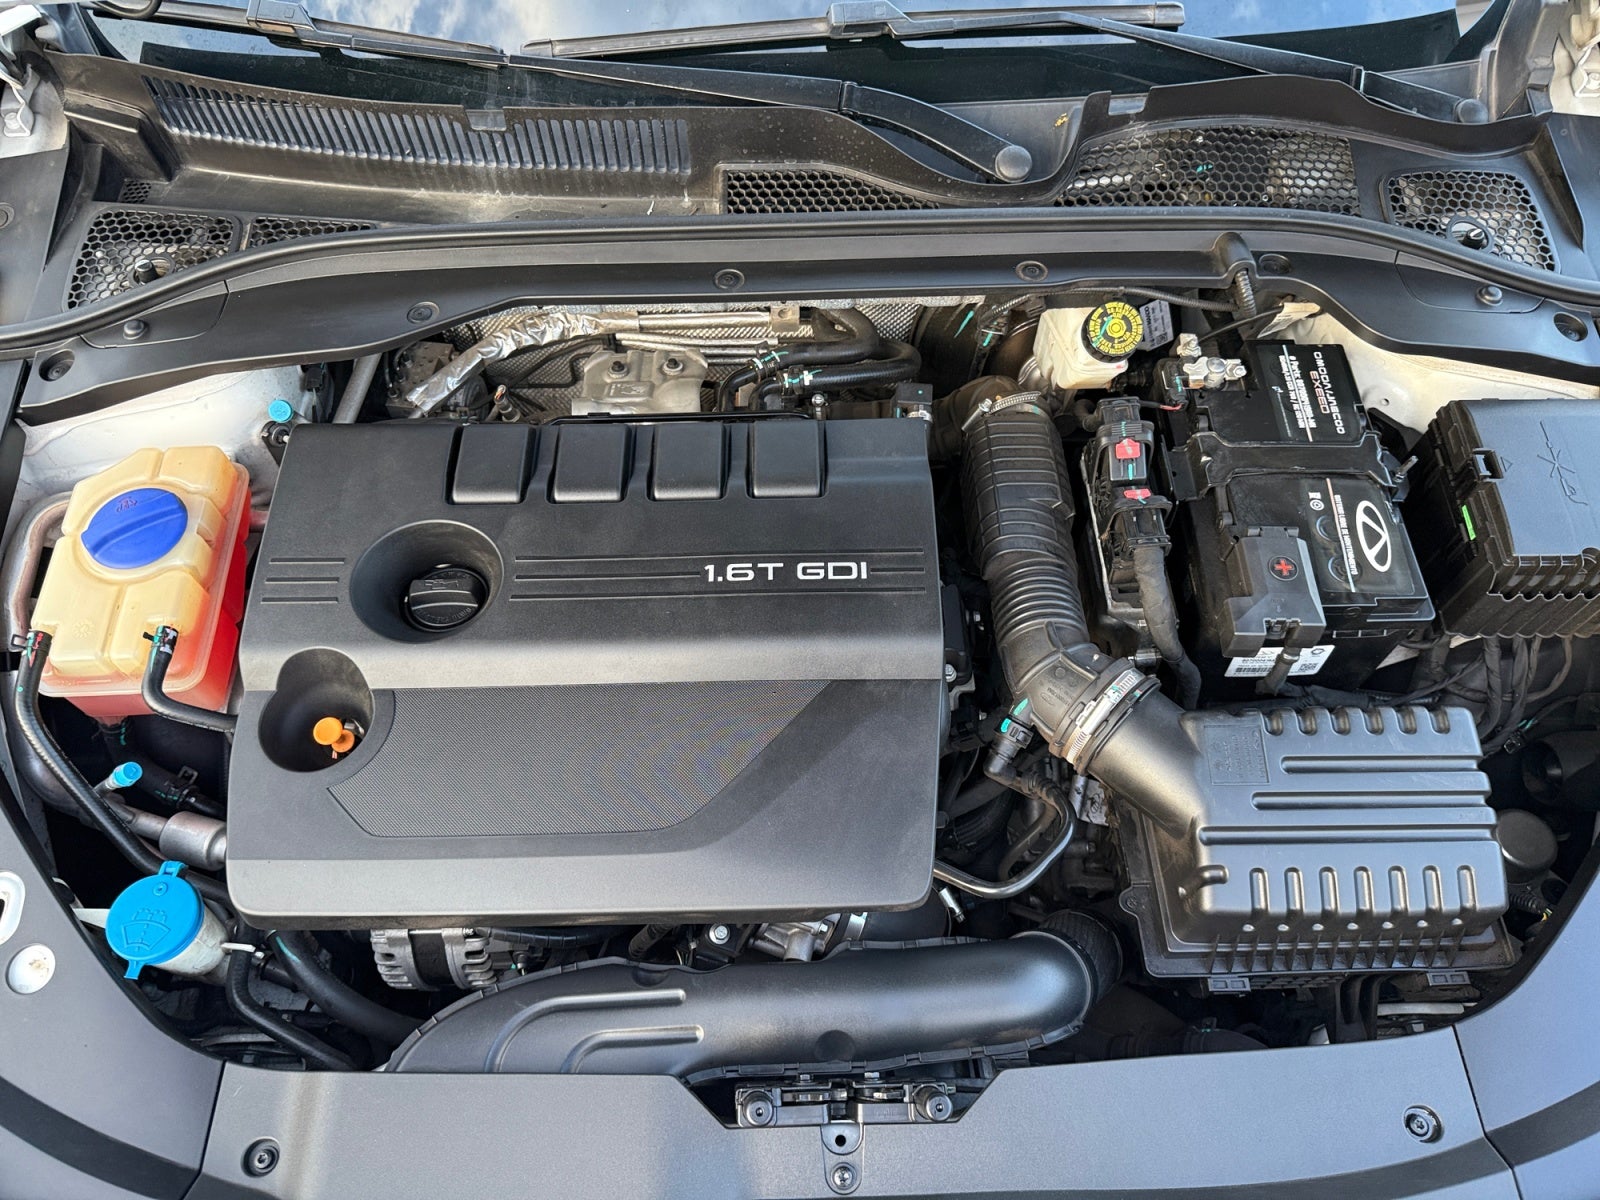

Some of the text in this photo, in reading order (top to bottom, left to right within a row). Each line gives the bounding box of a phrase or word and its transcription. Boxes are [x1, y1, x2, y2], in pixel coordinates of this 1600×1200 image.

[1309, 371, 1330, 414] EXEED
[704, 562, 867, 582] 1.6T GDI
